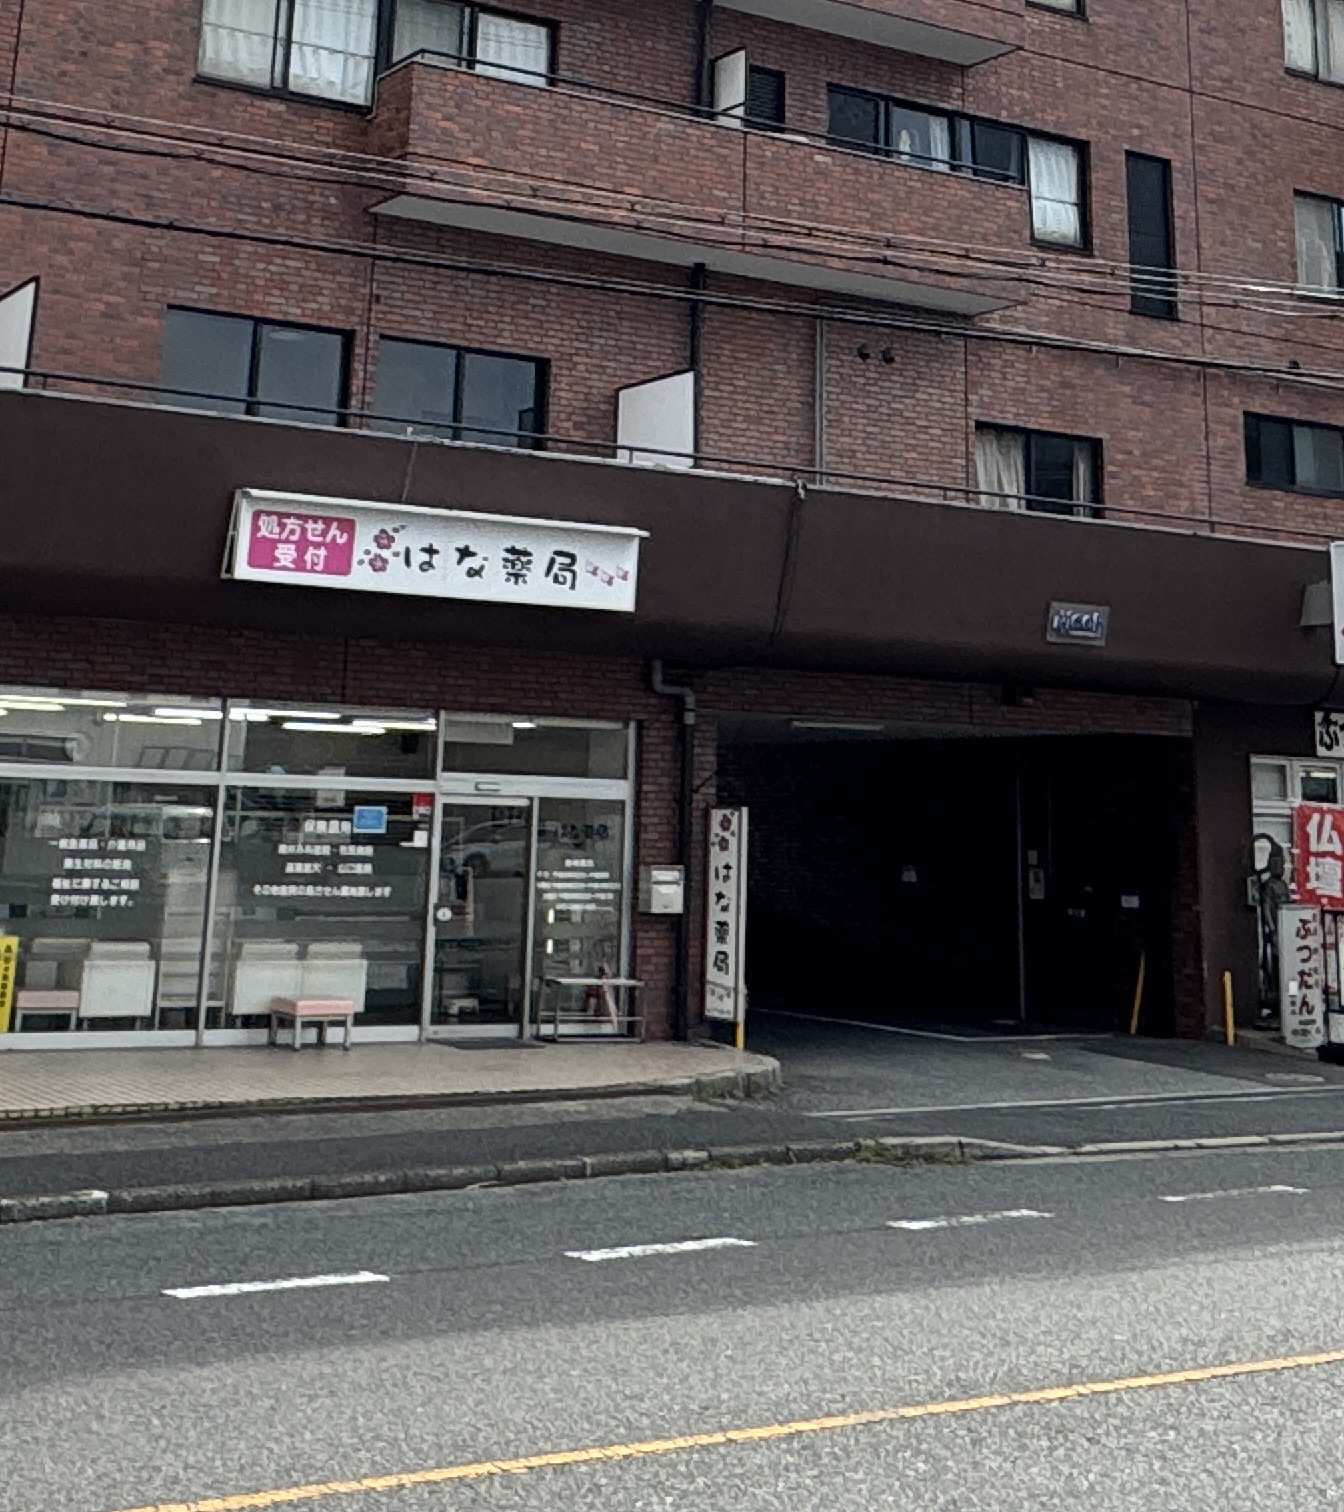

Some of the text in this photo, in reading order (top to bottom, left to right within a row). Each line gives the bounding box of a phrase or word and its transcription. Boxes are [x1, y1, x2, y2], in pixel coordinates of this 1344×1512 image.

[256, 514, 349, 544] 処方せん
[273, 544, 328, 571] 受付
[403, 543, 578, 589] はな薬局
[1294, 916, 1317, 1017] ぶつだん
